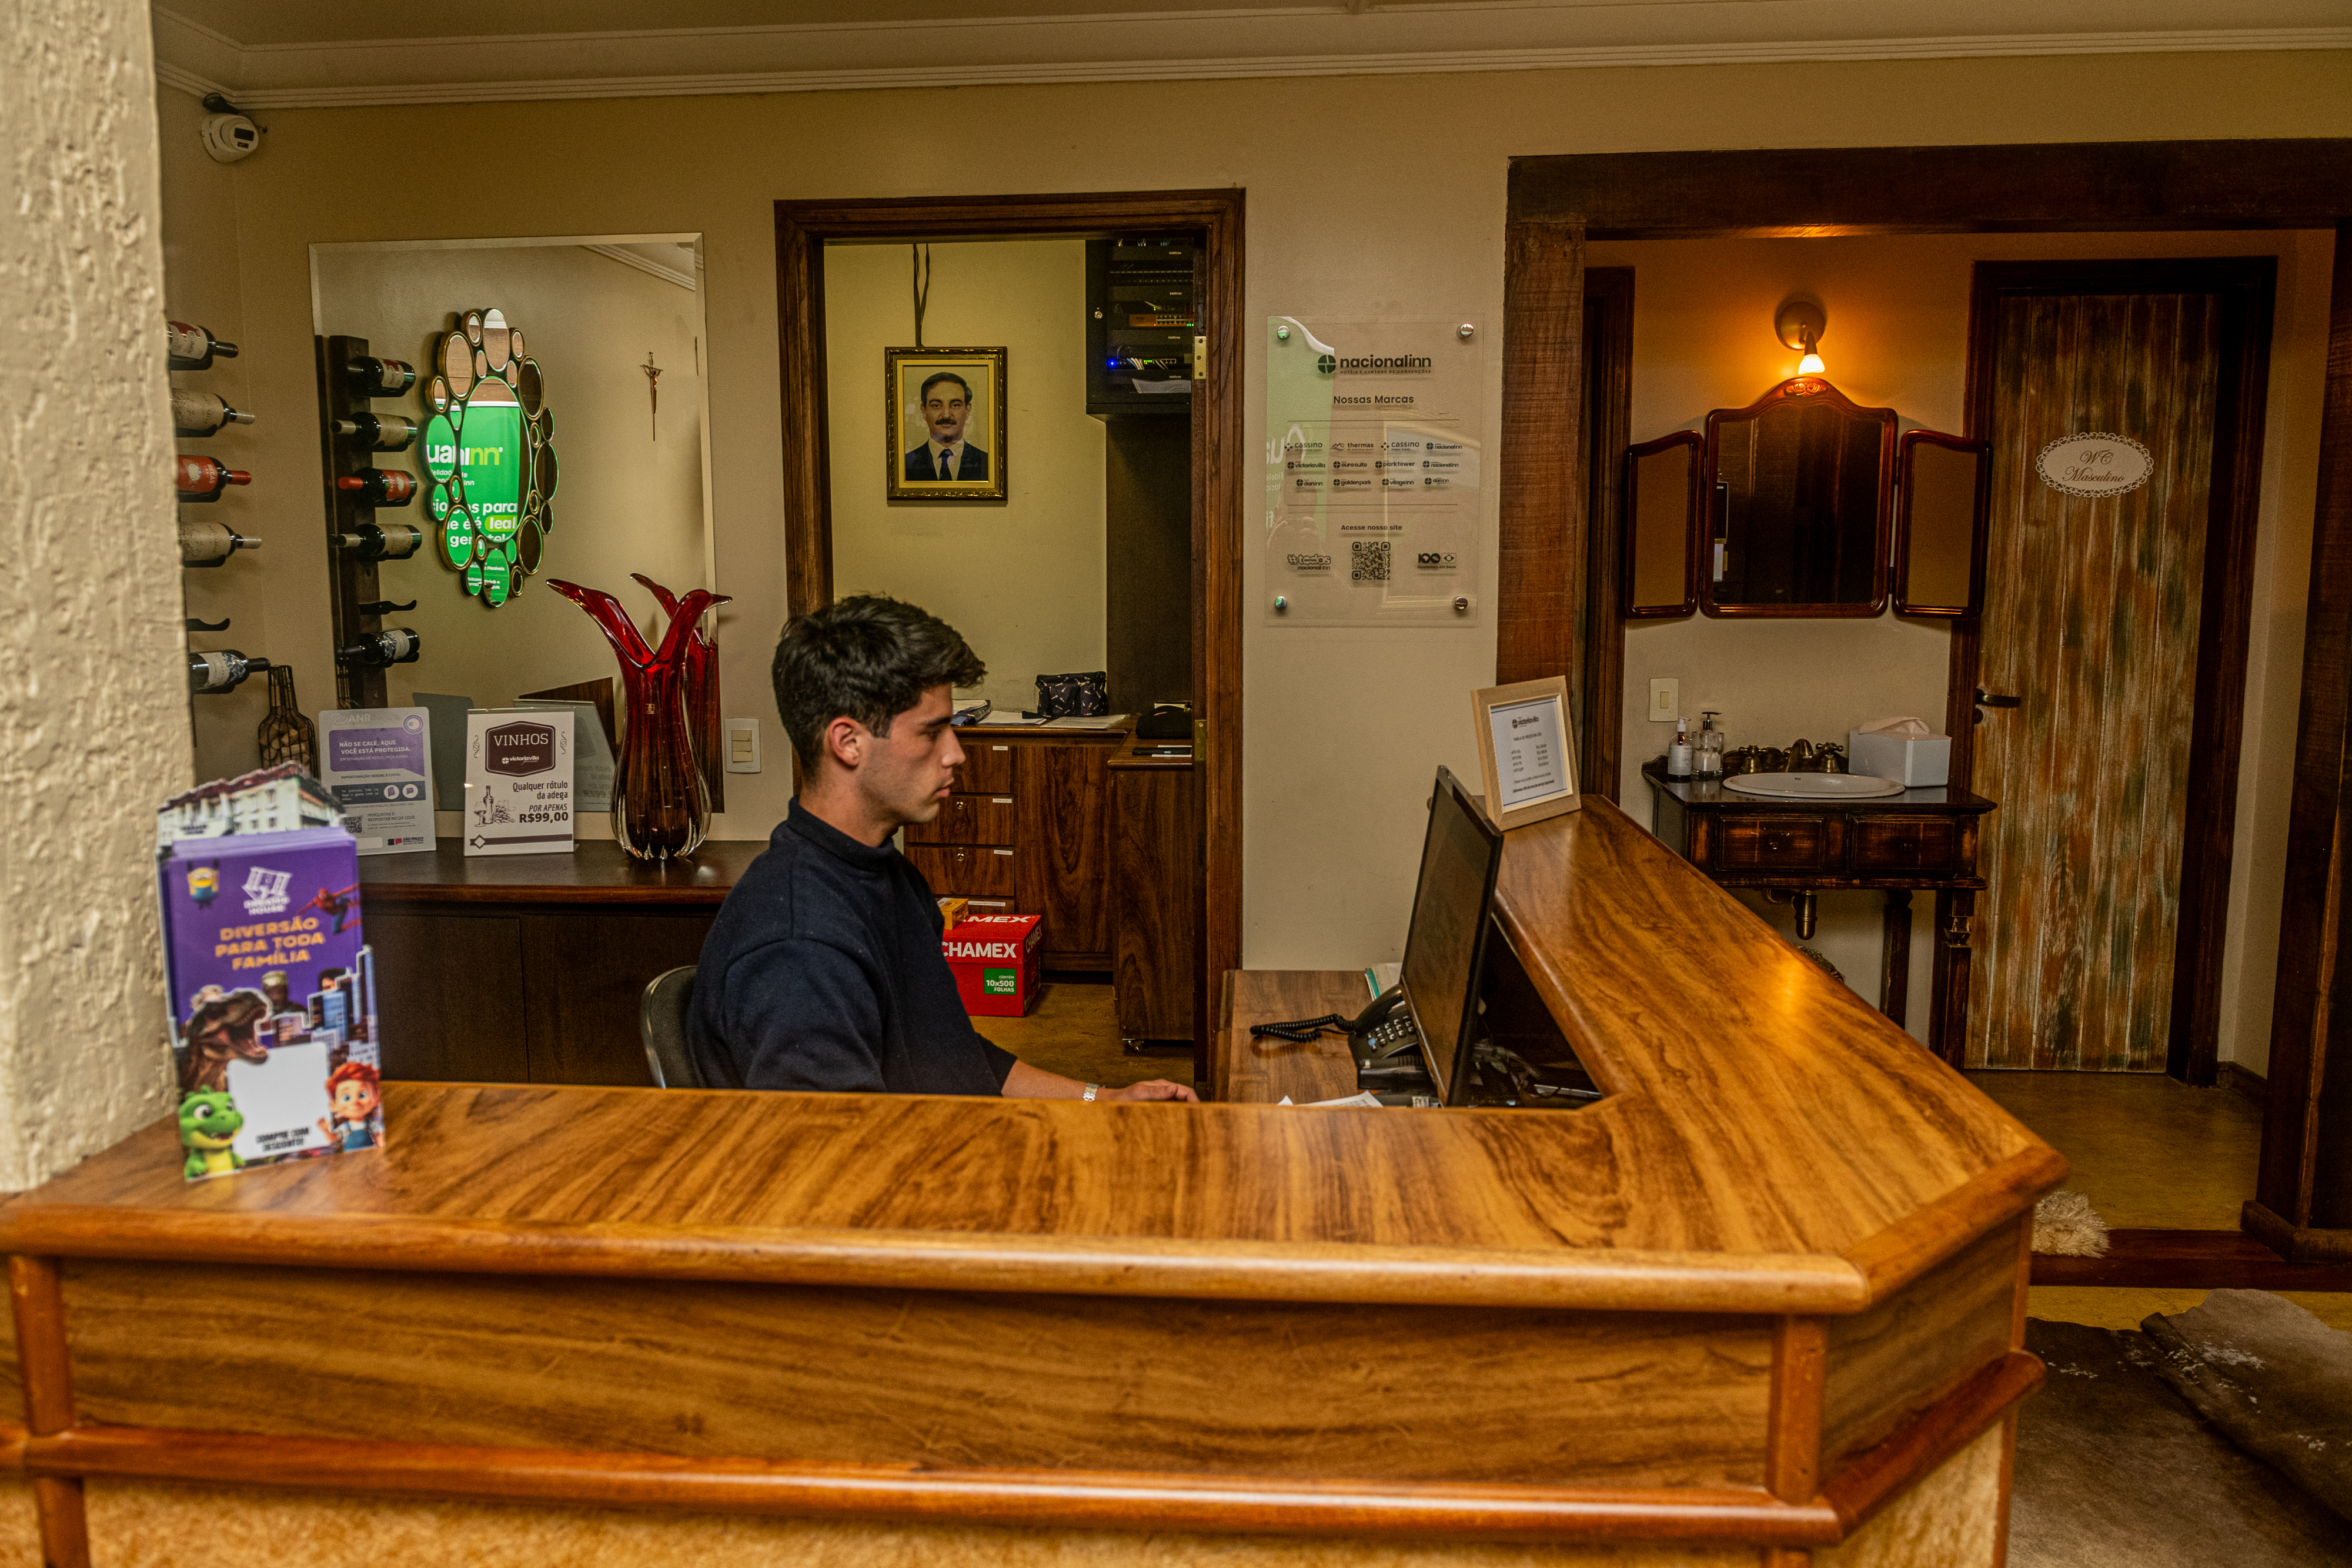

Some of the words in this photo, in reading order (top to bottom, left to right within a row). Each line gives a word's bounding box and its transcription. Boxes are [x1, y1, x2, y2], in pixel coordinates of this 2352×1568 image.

[1340, 354, 1431, 368] nacionalinn
[1334, 396, 1372, 404] Nossas
[1375, 396, 1414, 404] Marcas
[2080, 449, 2113, 464] WC
[2062, 466, 2124, 482] Masculino
[482, 503, 518, 516] para
[489, 516, 516, 529] leal
[349, 714, 371, 723] ANR
[493, 733, 549, 746] VINHOS
[513, 782, 544, 793] Qualquer
[547, 780, 567, 789] rótulo
[537, 791, 545, 800] da
[547, 791, 568, 800] adega
[543, 803, 567, 811] APENAS
[519, 811, 569, 823] R$99,00
[220, 916, 319, 941] DIVERSÃO
[215, 940, 268, 957] PARA
[272, 932, 325, 949] TODA
[232, 950, 310, 970] FAMÍLIA
